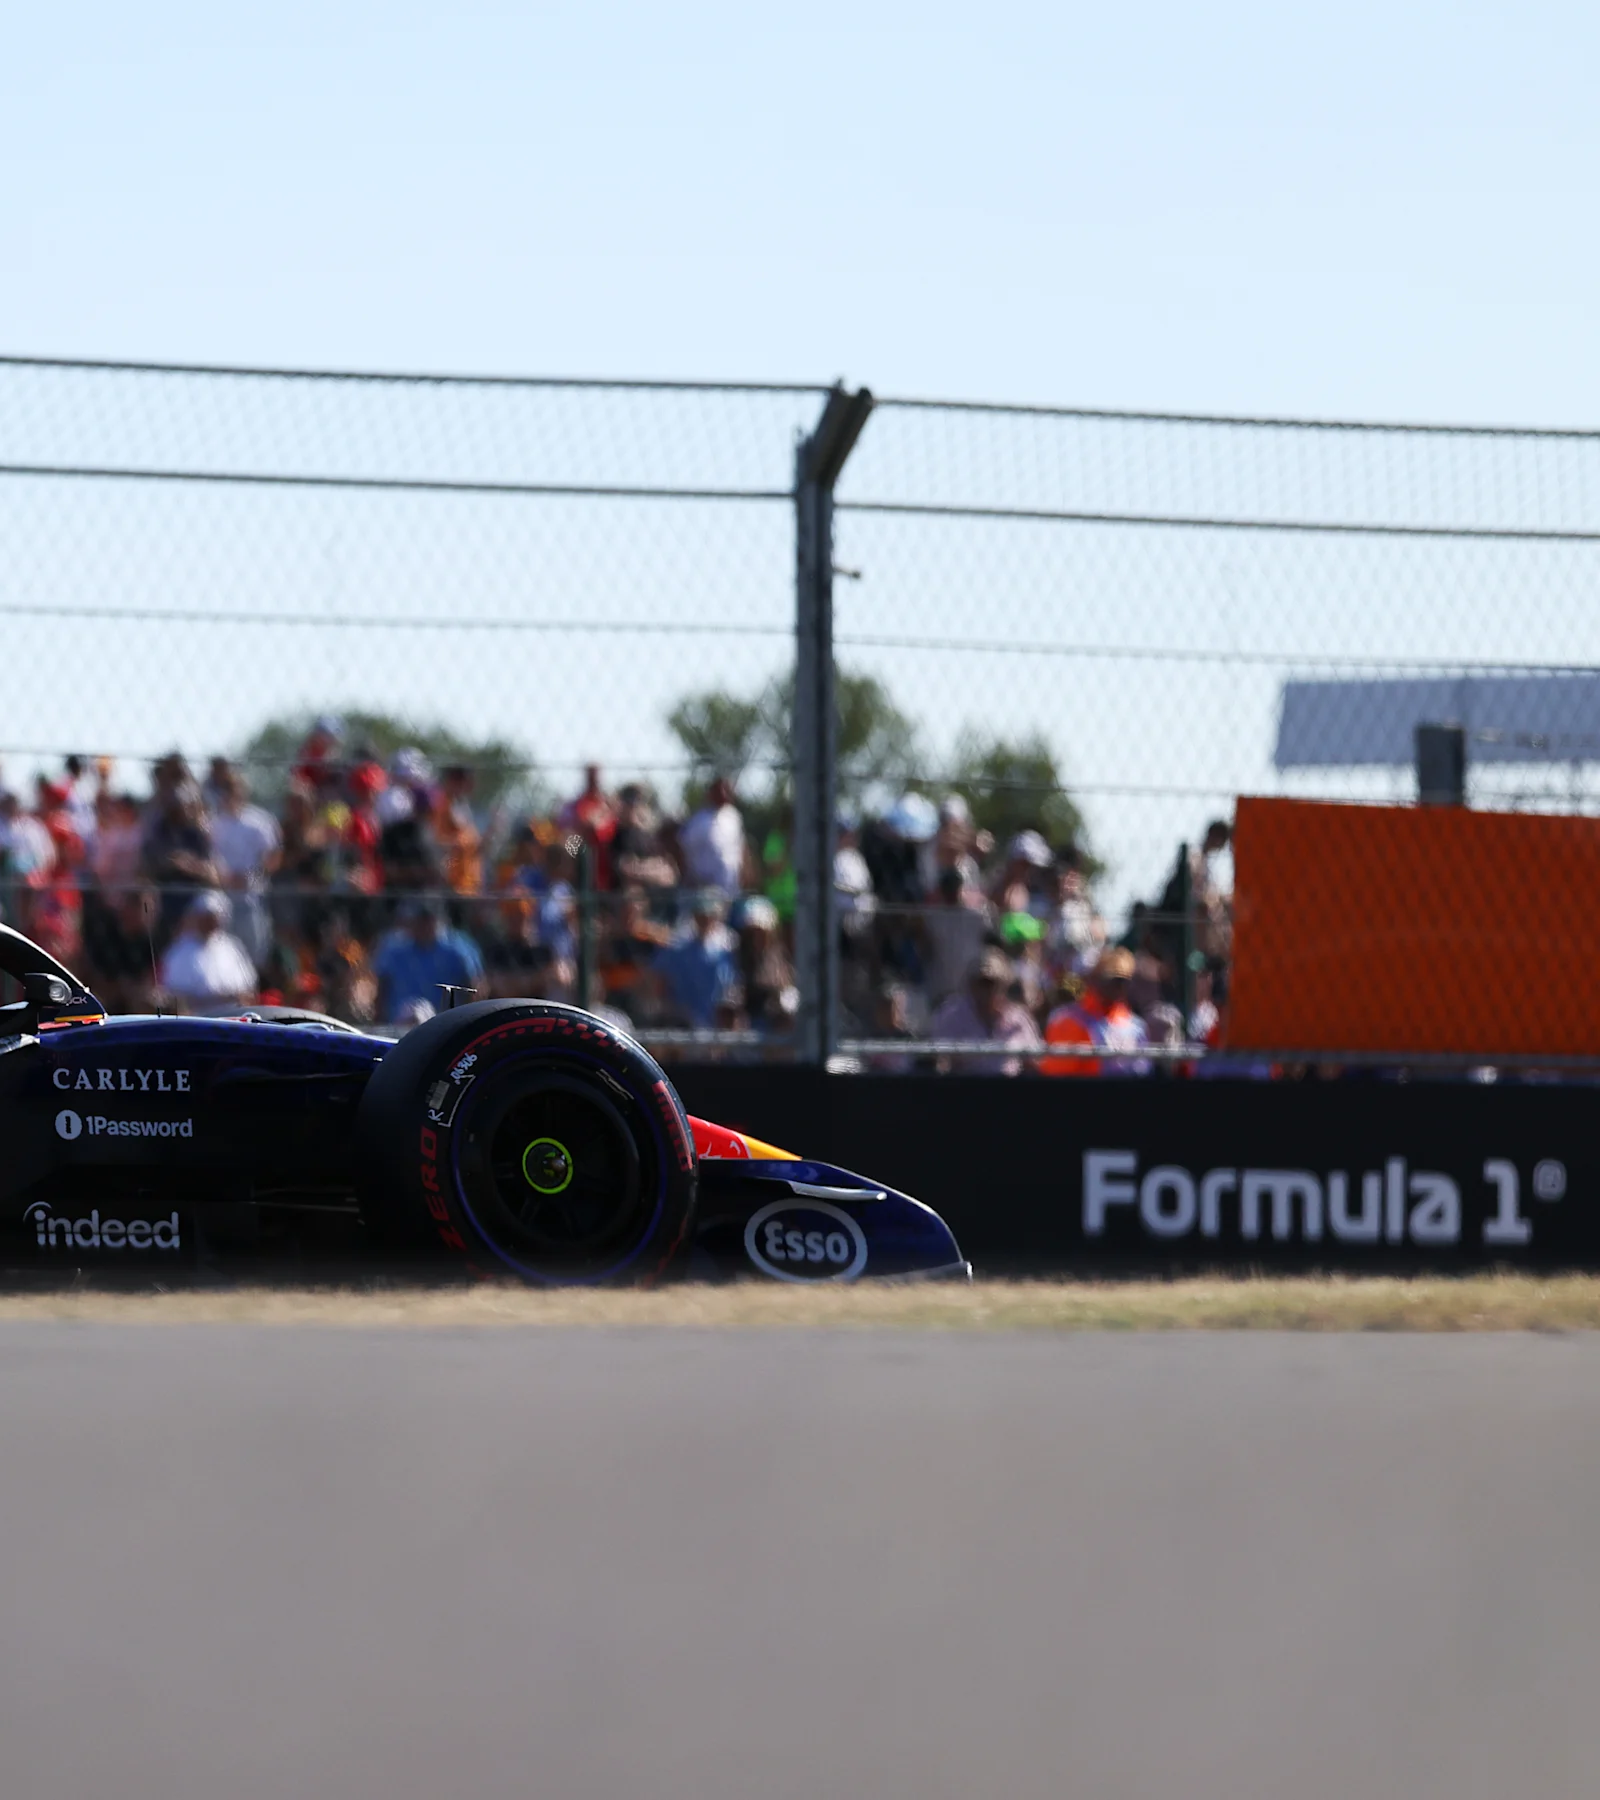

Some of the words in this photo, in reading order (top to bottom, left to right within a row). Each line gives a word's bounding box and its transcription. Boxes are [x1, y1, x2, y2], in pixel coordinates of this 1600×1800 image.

[52, 1067, 192, 1092] CARLYLE
[85, 1115, 195, 1138] 1Password
[420, 1124, 468, 1252] ZERO
[1082, 1148, 1462, 1246] Formula
[31, 1207, 181, 1250] indeed
[764, 1220, 849, 1263] Esso
